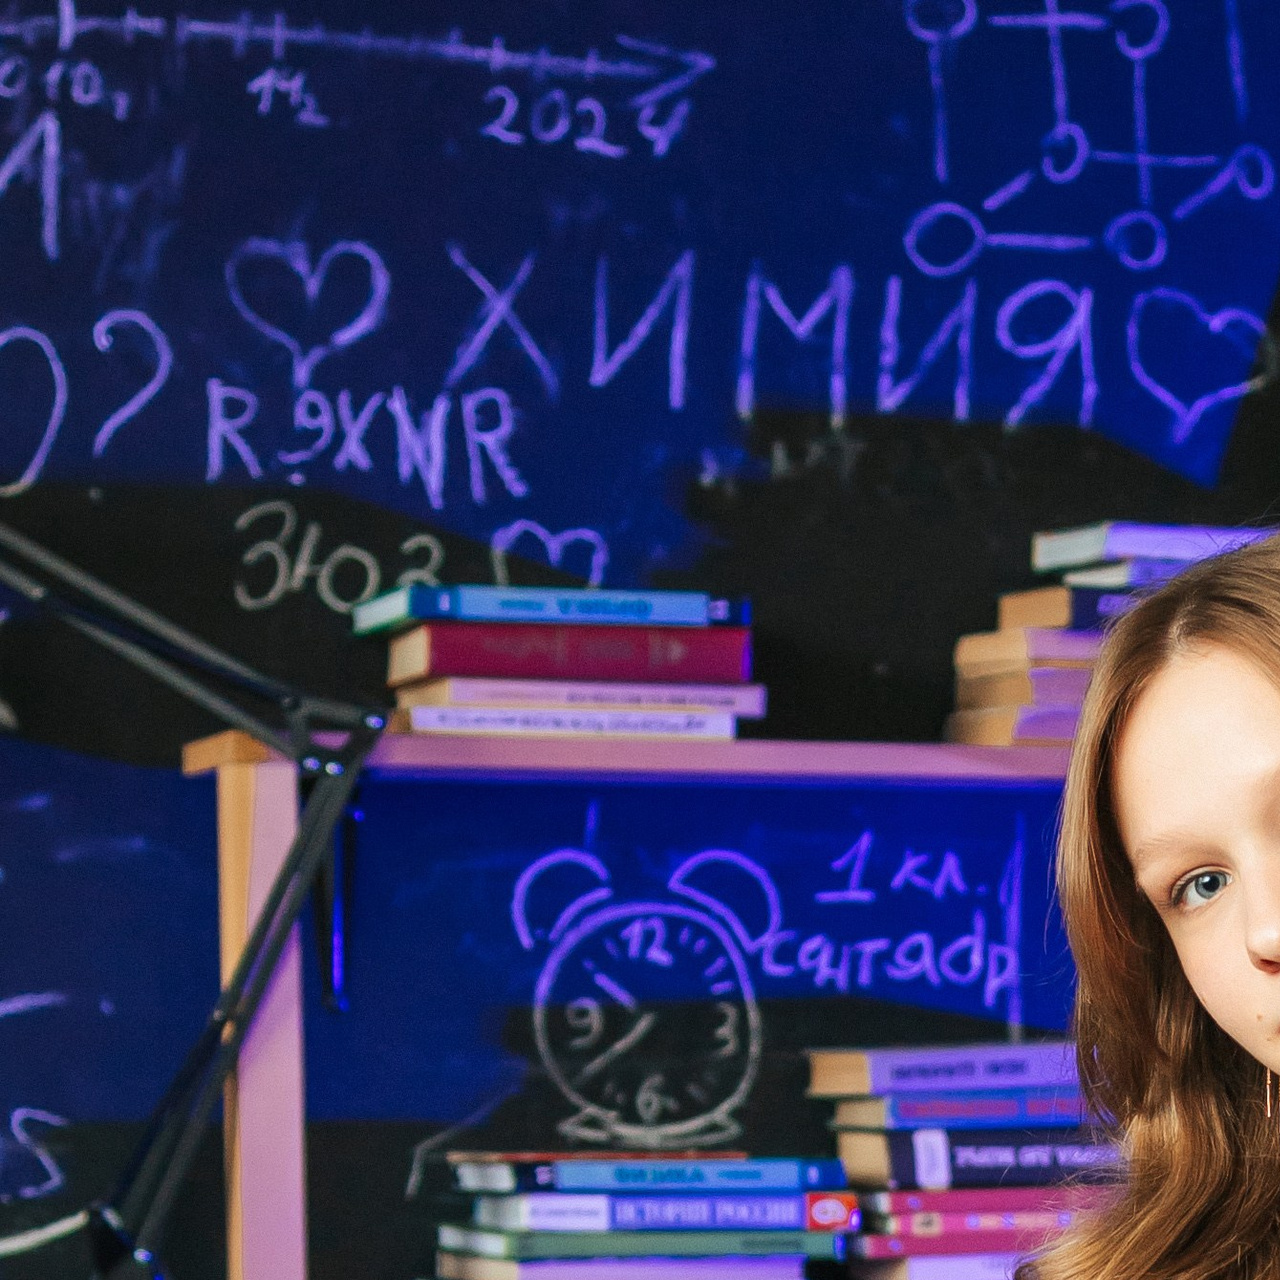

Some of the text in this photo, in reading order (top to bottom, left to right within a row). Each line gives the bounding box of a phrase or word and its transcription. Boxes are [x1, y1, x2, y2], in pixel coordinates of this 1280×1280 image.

[482, 85, 692, 157] 2024
[443, 240, 1098, 430] ХИМИЯ
[620, 914, 674, 970] 12
[566, 998, 739, 1059] 9 3
[634, 1072, 664, 1123] 6
